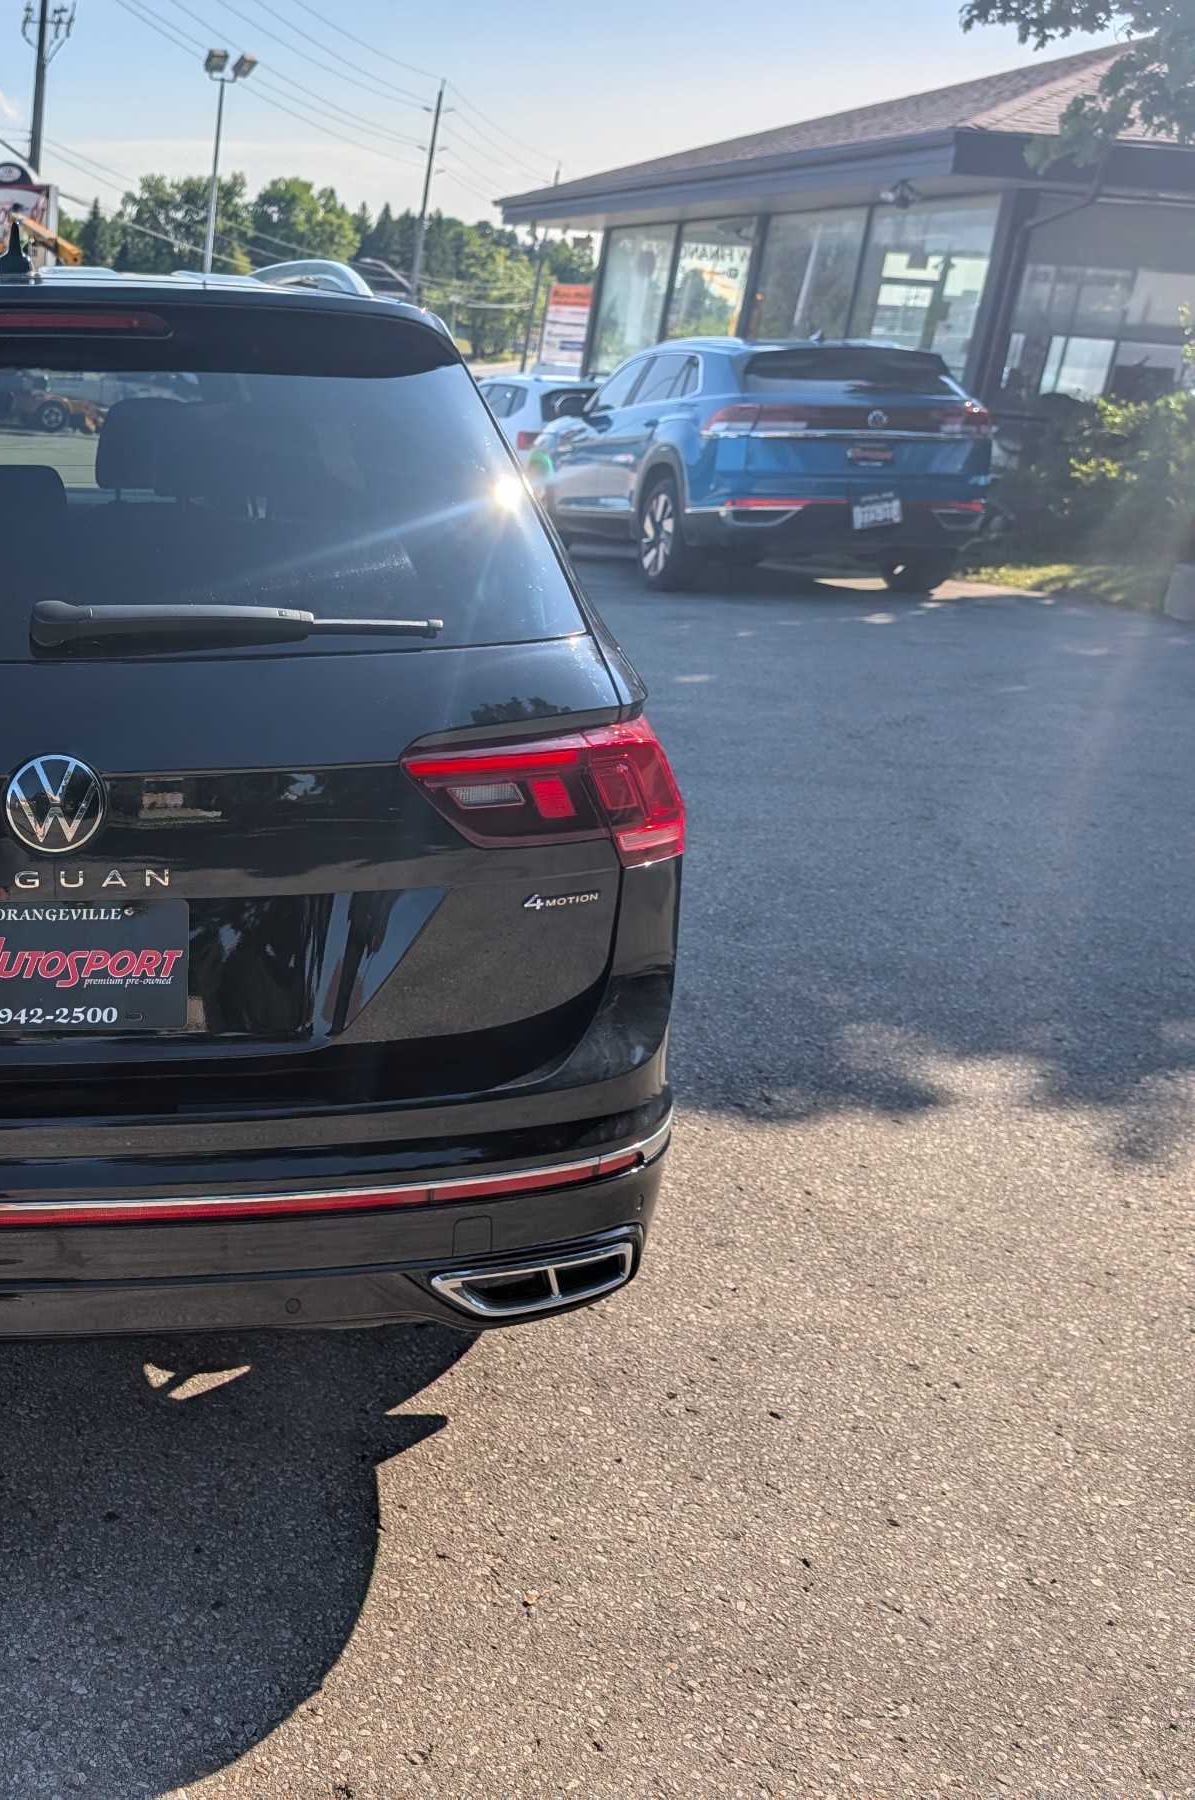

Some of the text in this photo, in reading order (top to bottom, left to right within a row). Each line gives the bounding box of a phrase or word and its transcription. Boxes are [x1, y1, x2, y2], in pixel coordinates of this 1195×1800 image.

[524, 893, 599, 910] 4MOTION
[84, 976, 173, 988] premium pre-owned
